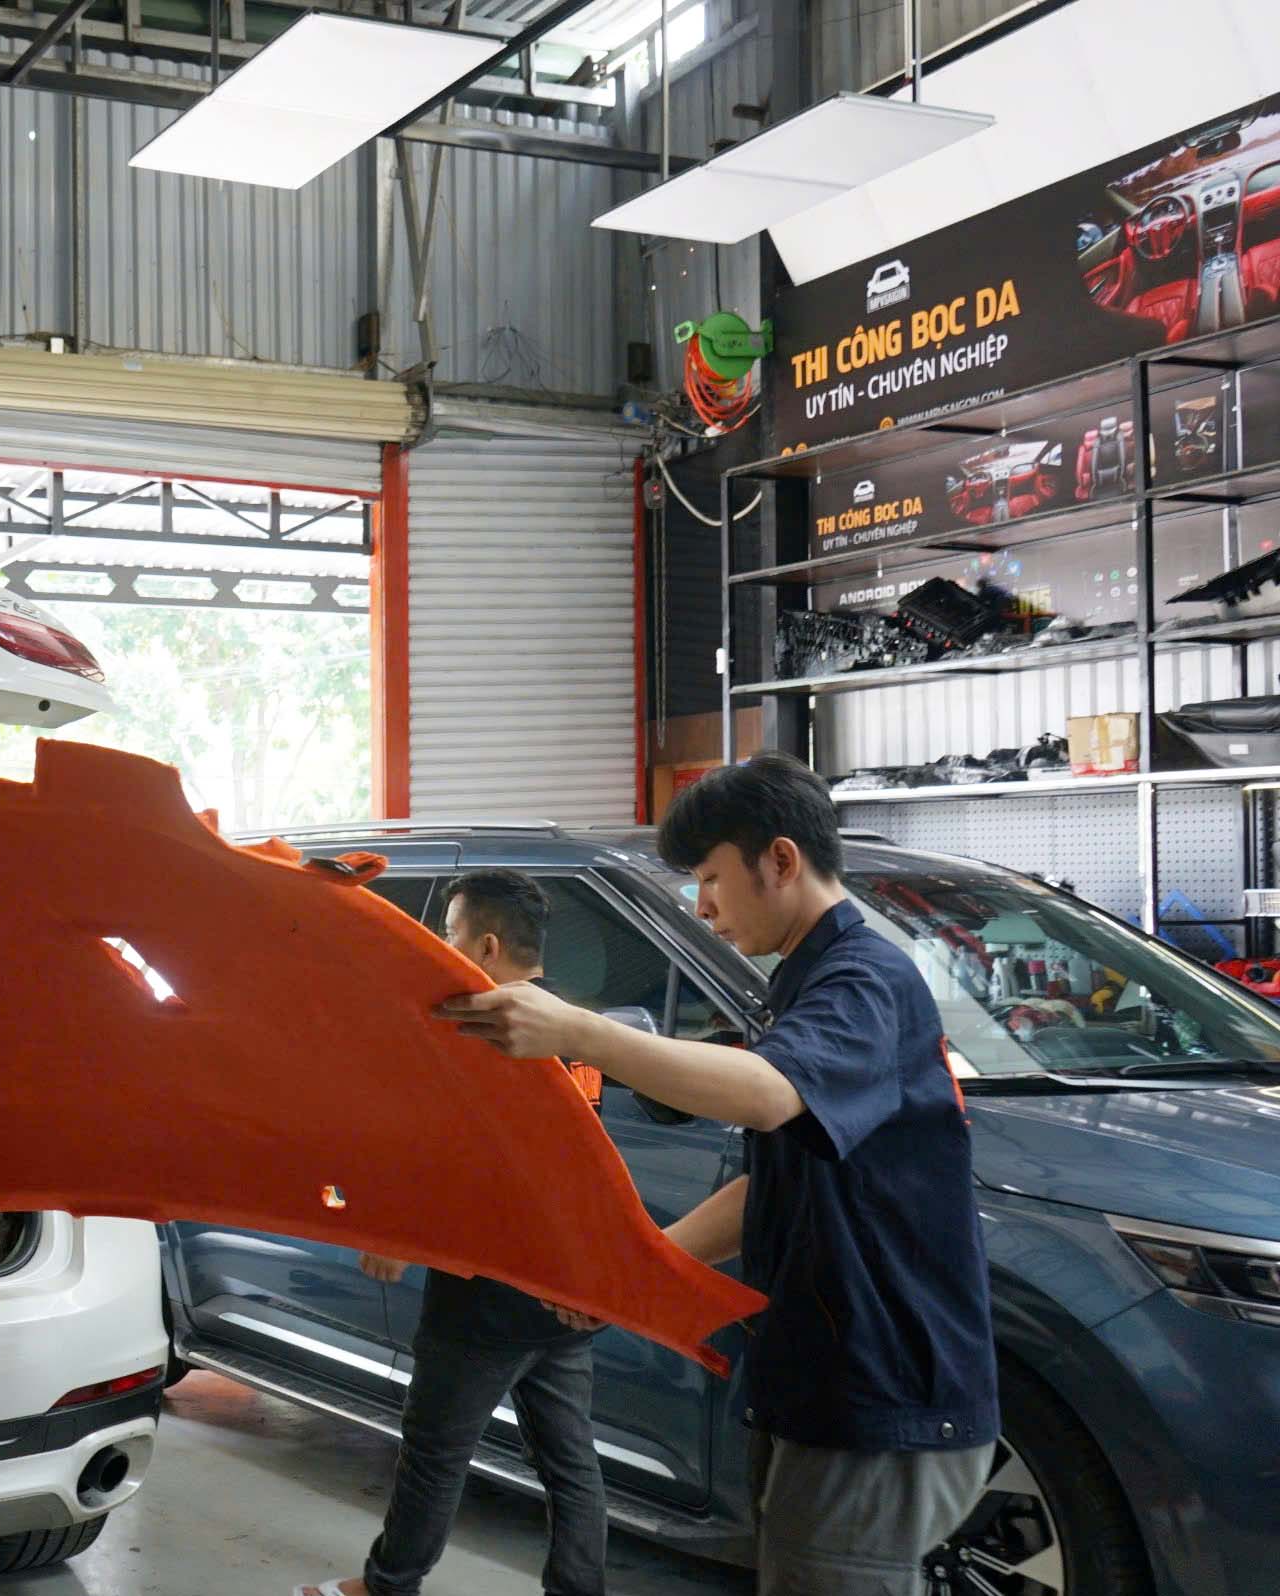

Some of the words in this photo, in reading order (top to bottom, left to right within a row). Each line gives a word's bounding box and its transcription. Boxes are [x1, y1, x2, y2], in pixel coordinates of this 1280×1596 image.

[791, 345, 829, 389] THI
[836, 319, 903, 373] CÔNG
[911, 296, 966, 350] BỌC
[976, 279, 1020, 328] DA
[806, 391, 829, 419] UY
[828, 382, 854, 412] TÍN
[867, 357, 936, 400] CHUYÊN
[940, 333, 1009, 377] NGHIỆP
[816, 515, 836, 536] THI
[839, 507, 871, 531] CÔNG
[903, 496, 923, 518] DA
[839, 584, 895, 606] ANDROID
